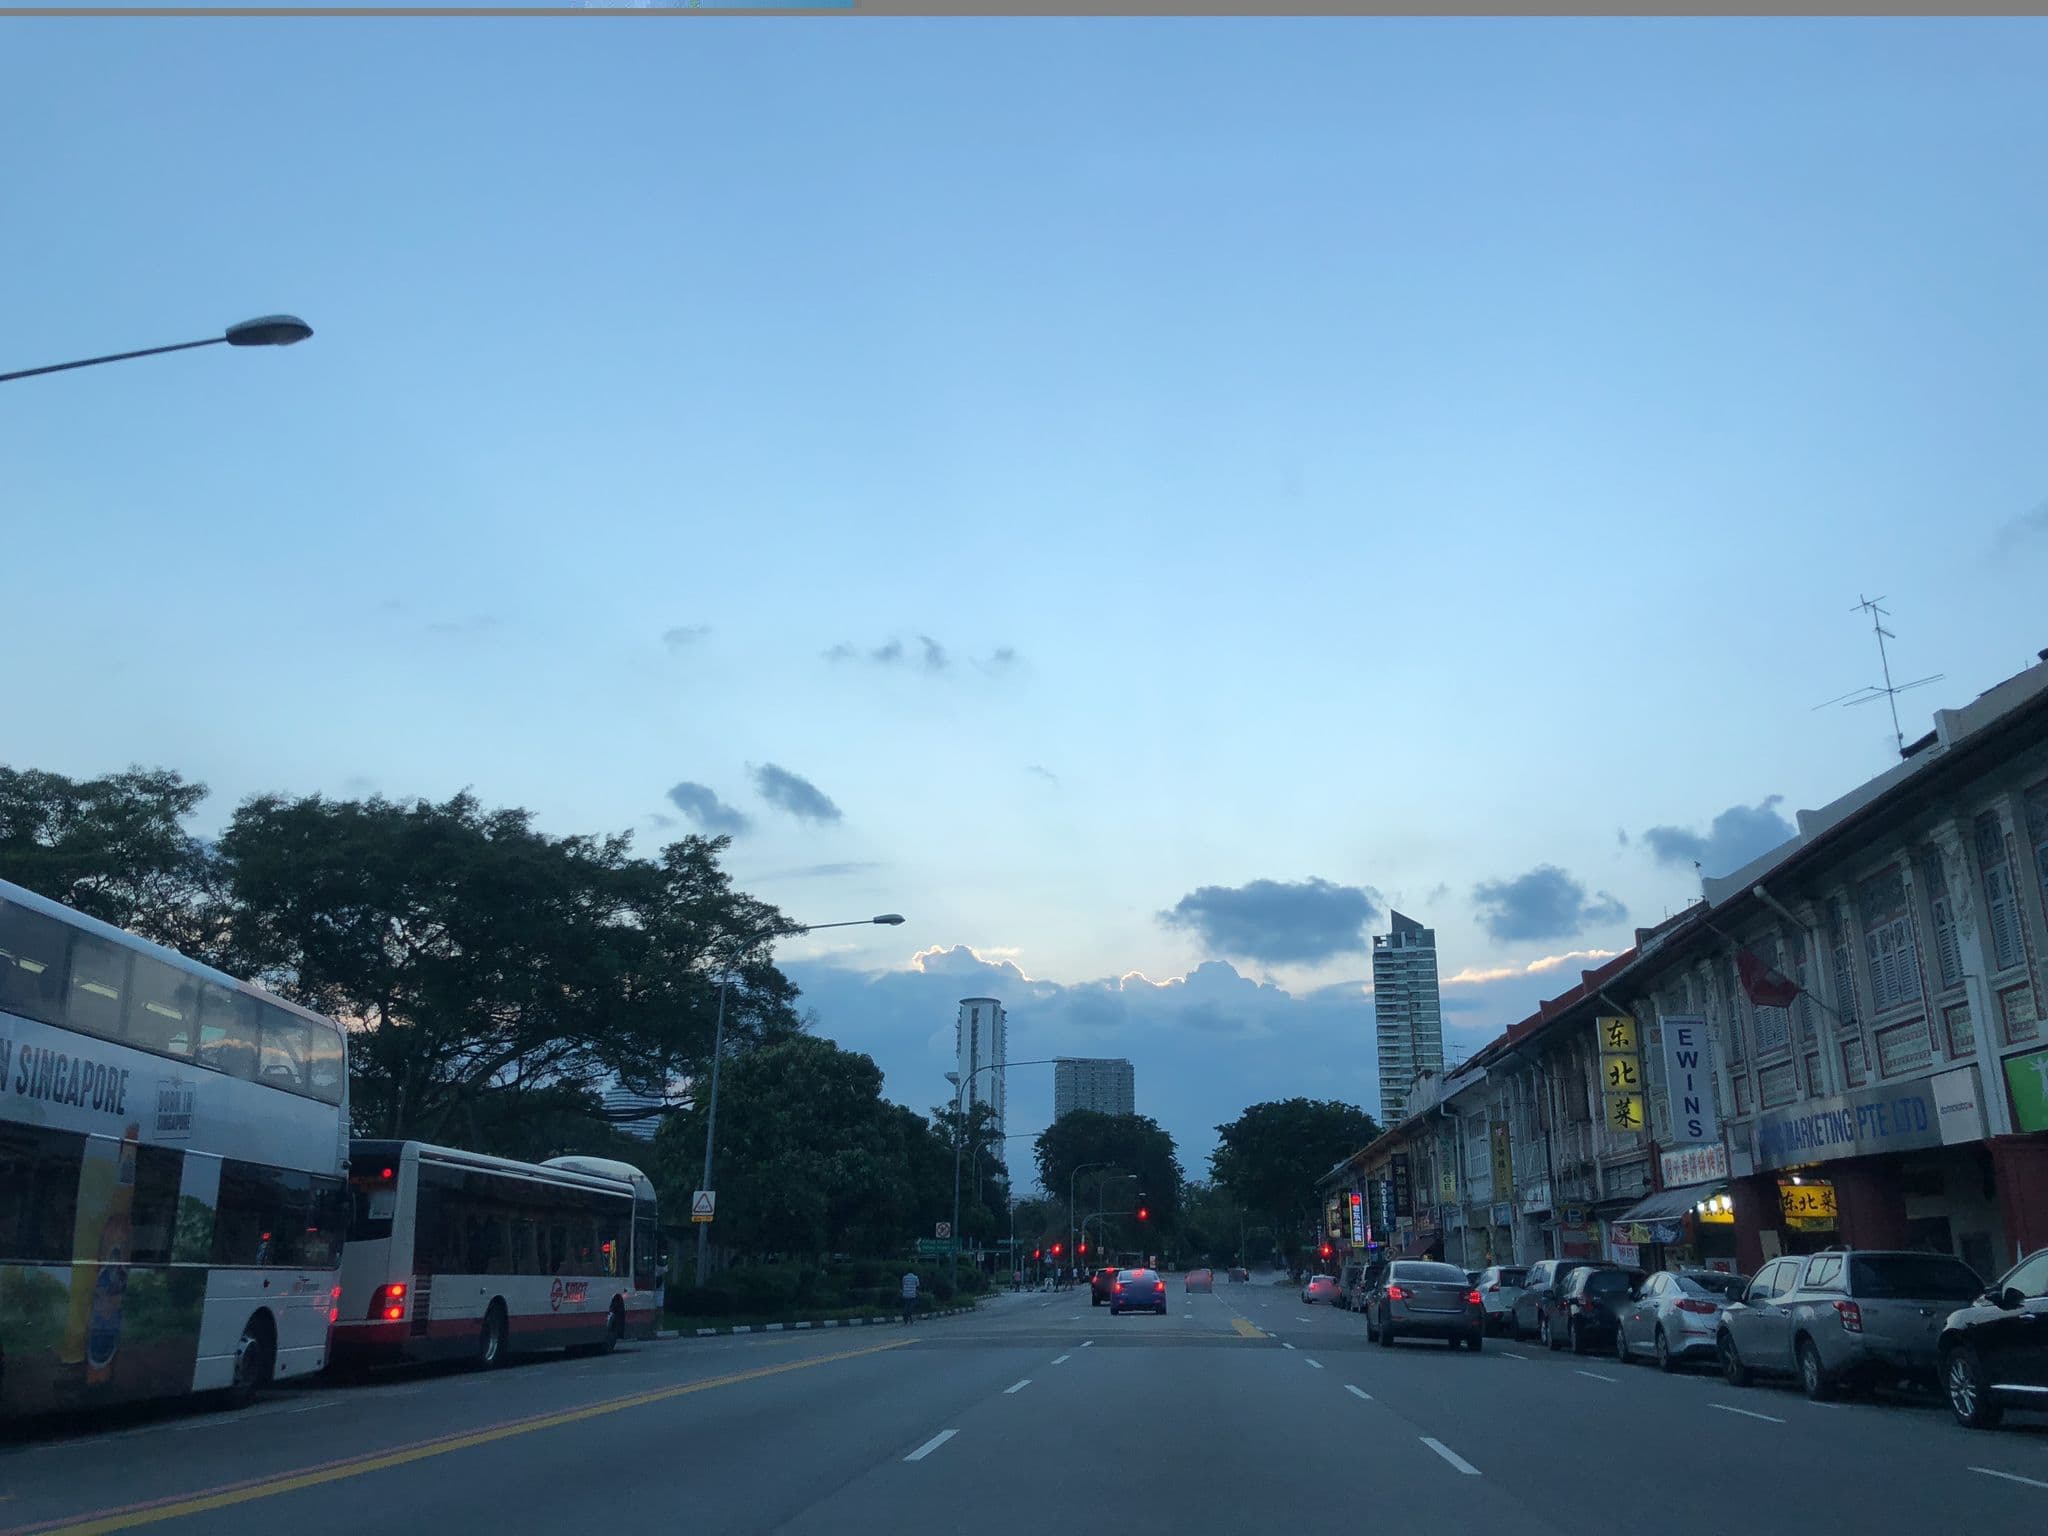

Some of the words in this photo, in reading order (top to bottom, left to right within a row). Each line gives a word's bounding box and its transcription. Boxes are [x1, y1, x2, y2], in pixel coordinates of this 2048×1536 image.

[16, 1044, 129, 1115] SINGAPORE
[1606, 1019, 1640, 1128] 东北菜
[1677, 1028, 1703, 1137] EWINS
[1784, 1108, 1853, 1153] MARKETING
[1380, 1180, 1388, 1225] HOSTEL
[1783, 1190, 1838, 1212] 东北菜
